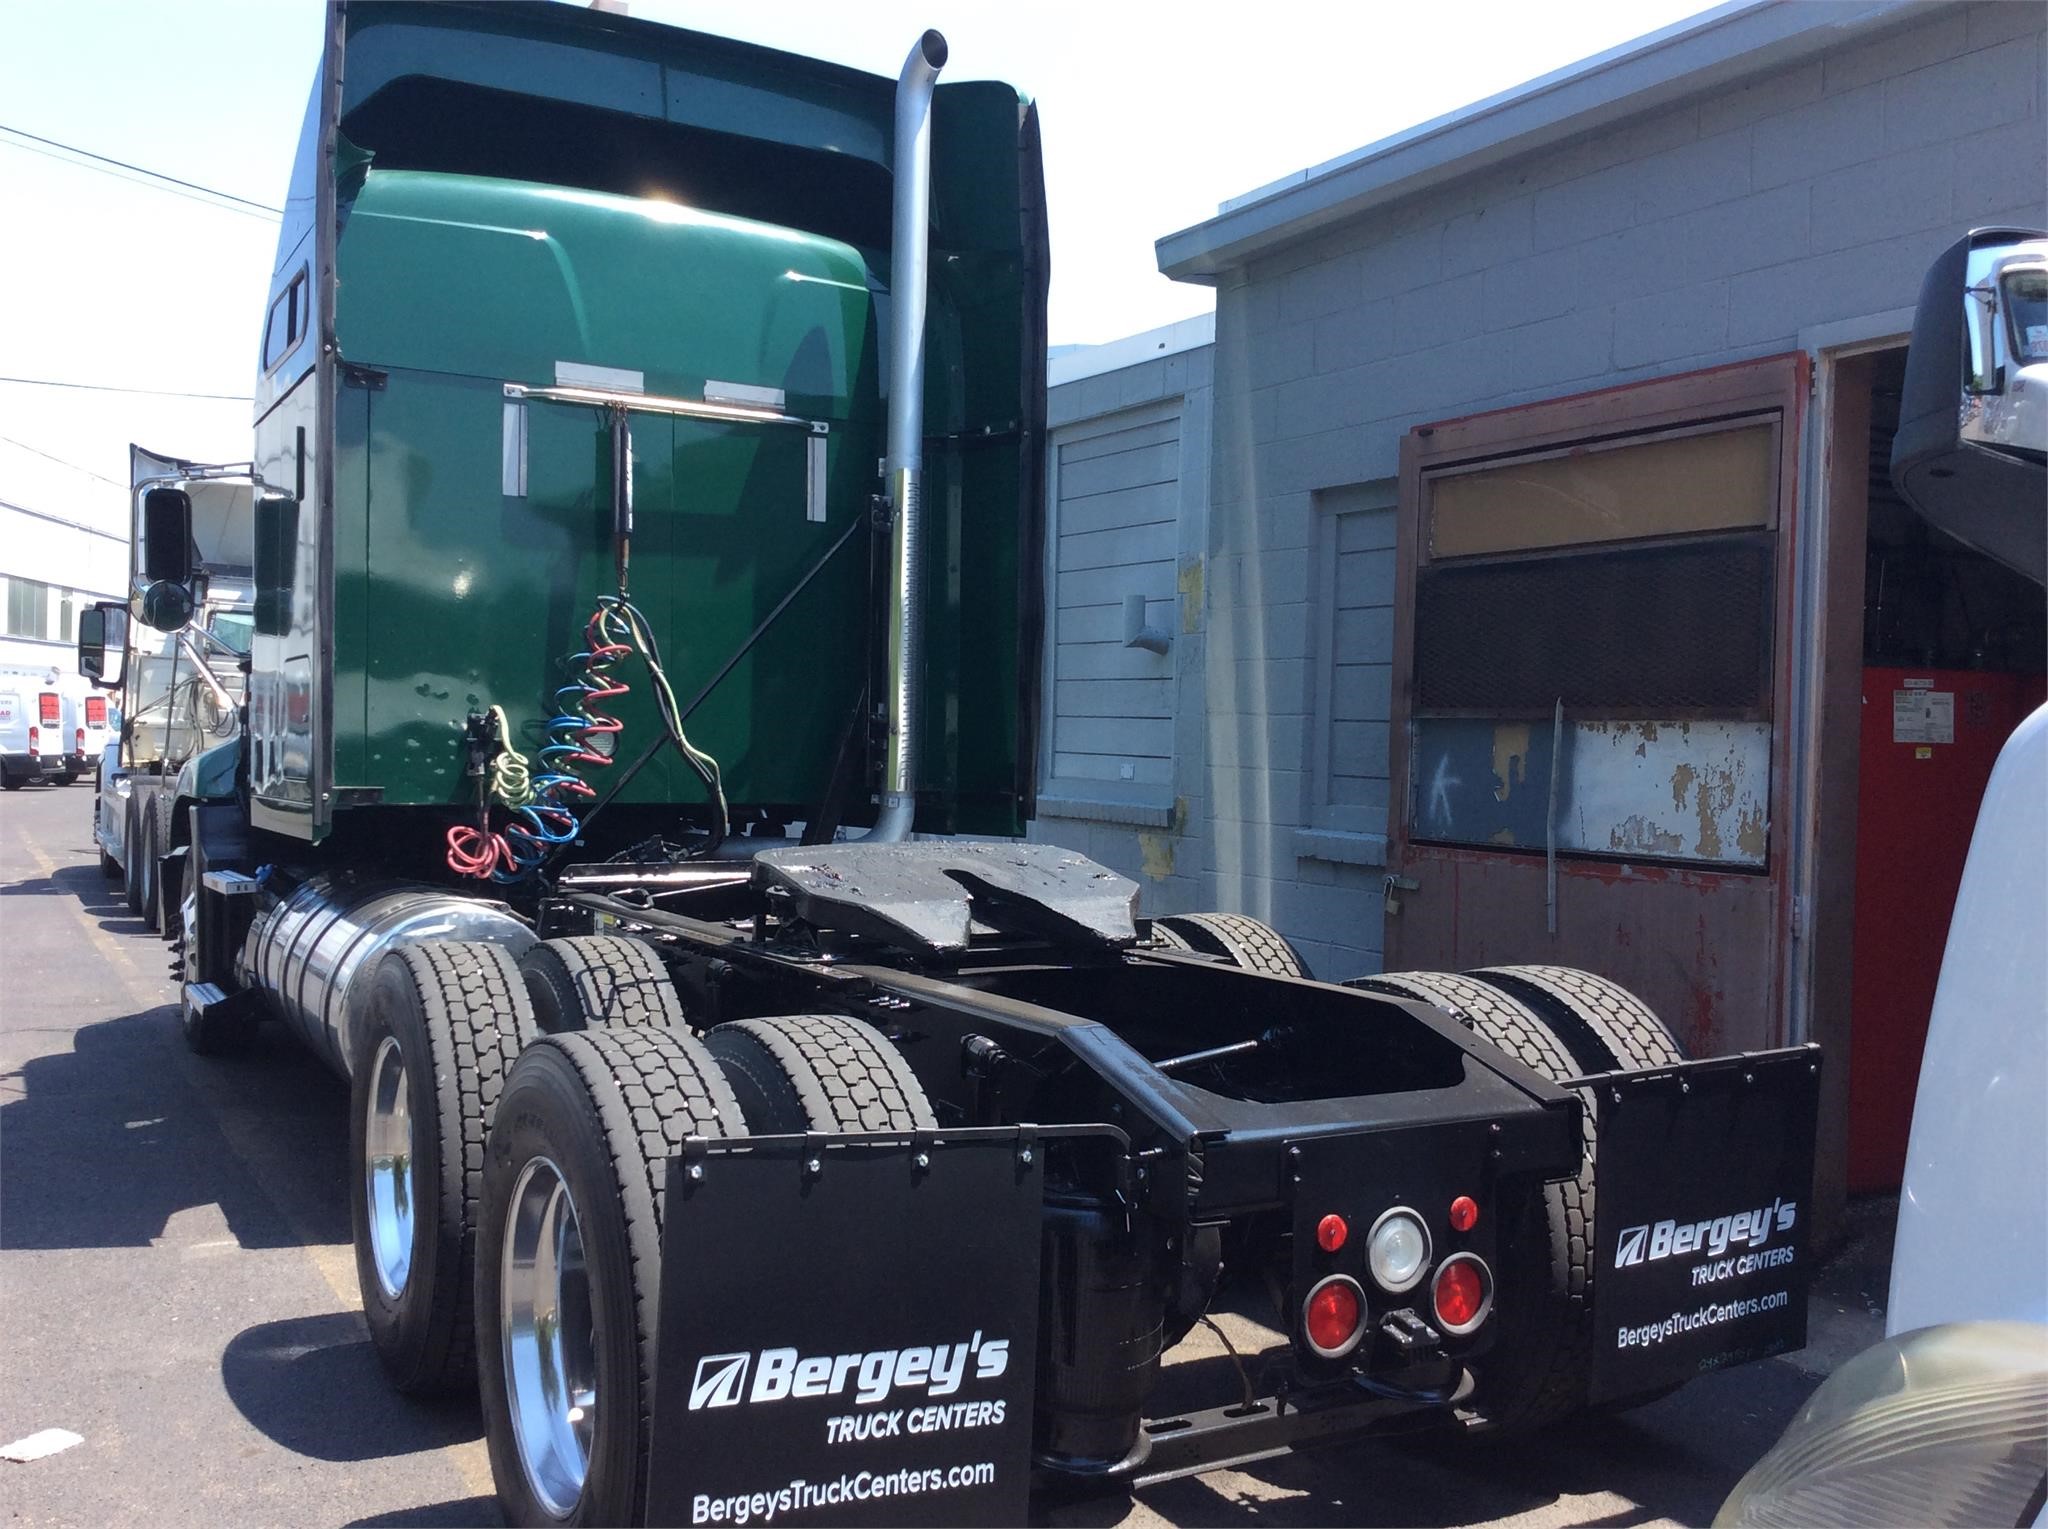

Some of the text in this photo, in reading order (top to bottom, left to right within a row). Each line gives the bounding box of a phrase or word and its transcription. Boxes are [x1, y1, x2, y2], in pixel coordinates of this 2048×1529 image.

[1648, 1197, 1796, 1261] Bergey's
[1692, 1246, 1794, 1286] TRUCK CENTERS
[1618, 1292, 1787, 1348] BergeysTruckCenters.com
[750, 1331, 1009, 1404] Bergey's
[827, 1400, 1006, 1444] TRUCK CENTERS
[693, 1463, 994, 1524] BergeysTruckCenters.com
